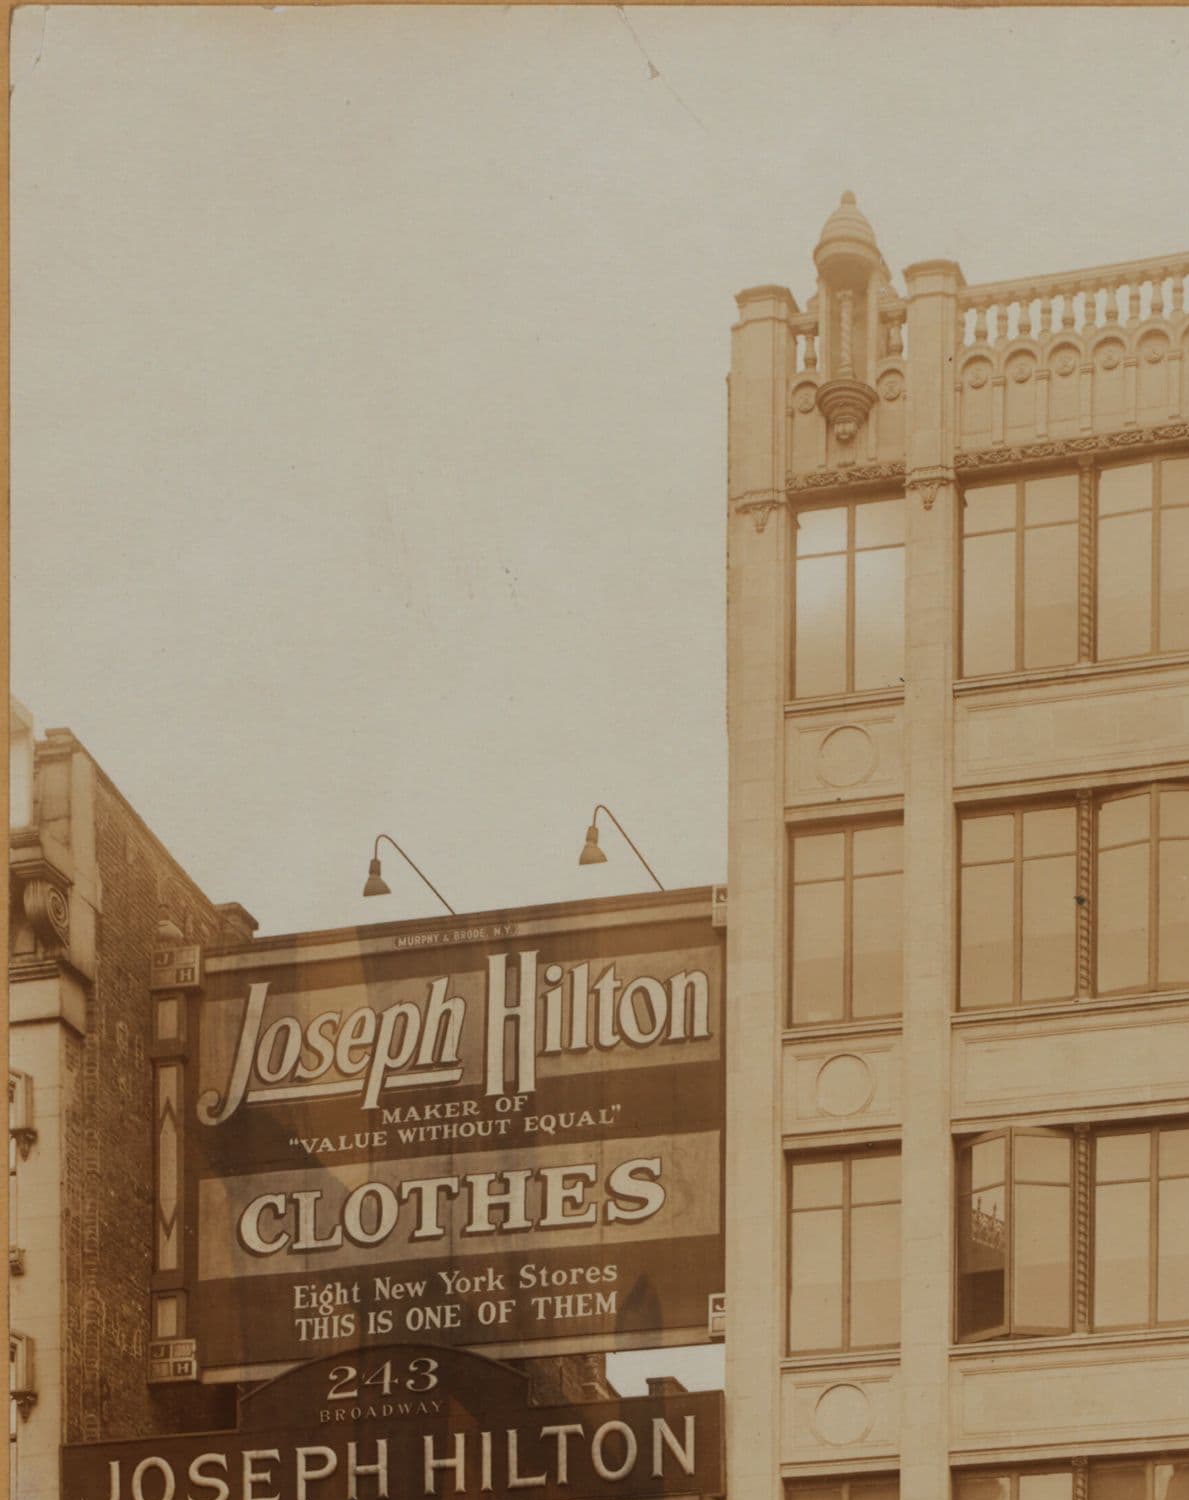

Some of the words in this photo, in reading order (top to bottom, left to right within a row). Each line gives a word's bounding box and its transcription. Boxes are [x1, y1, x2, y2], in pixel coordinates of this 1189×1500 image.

[197, 976, 466, 1126] Joseph
[485, 950, 714, 1097] Hilton
[382, 1100, 480, 1126] MAKER
[495, 1095, 528, 1113] OF
[398, 1119, 511, 1144] WITHOUT
[239, 1157, 667, 1255] CLOTHES
[293, 1281, 361, 1315] Eight
[374, 1276, 427, 1300] New
[438, 1268, 504, 1295] York
[519, 1264, 618, 1289] Stores
[295, 1313, 355, 1342] THIS
[367, 1310, 393, 1335] IS
[406, 1304, 461, 1331] ONE
[478, 1300, 516, 1325] OF
[531, 1290, 618, 1320] THEM
[326, 1357, 440, 1400] 243
[319, 1400, 443, 1424] BROADWAY
[423, 1414, 697, 1496] HILTON
